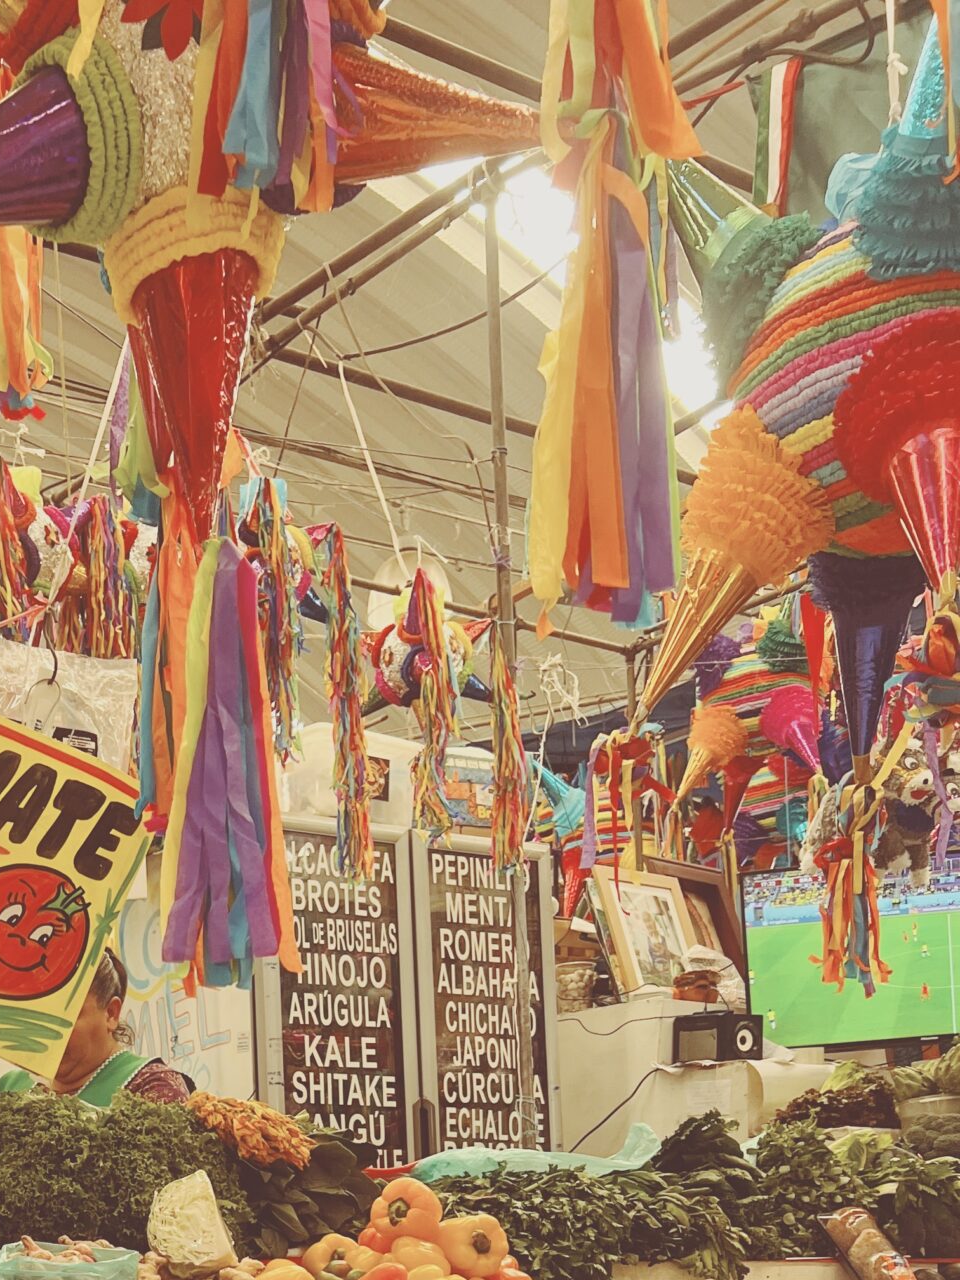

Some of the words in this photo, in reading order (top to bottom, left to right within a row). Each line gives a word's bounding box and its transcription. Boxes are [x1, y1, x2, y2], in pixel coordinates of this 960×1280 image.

[291, 878, 382, 918] BROTES
[445, 892, 512, 928] MENT
[293, 916, 311, 949] OL
[312, 922, 325, 944] DE
[326, 918, 398, 955] BRUSELAS
[440, 928, 529, 964] ROMER
[297, 952, 386, 989] HINOJO
[437, 963, 540, 1001] ALBAHAA
[289, 990, 391, 1028] ARÚGULA
[445, 1001, 536, 1037] CHICHAO
[304, 1035, 378, 1069] KALE
[292, 1071, 397, 1109] SHITAKE
[443, 1068, 545, 1104] CÚRCUA
[446, 1107, 545, 1143] ECHALOE
